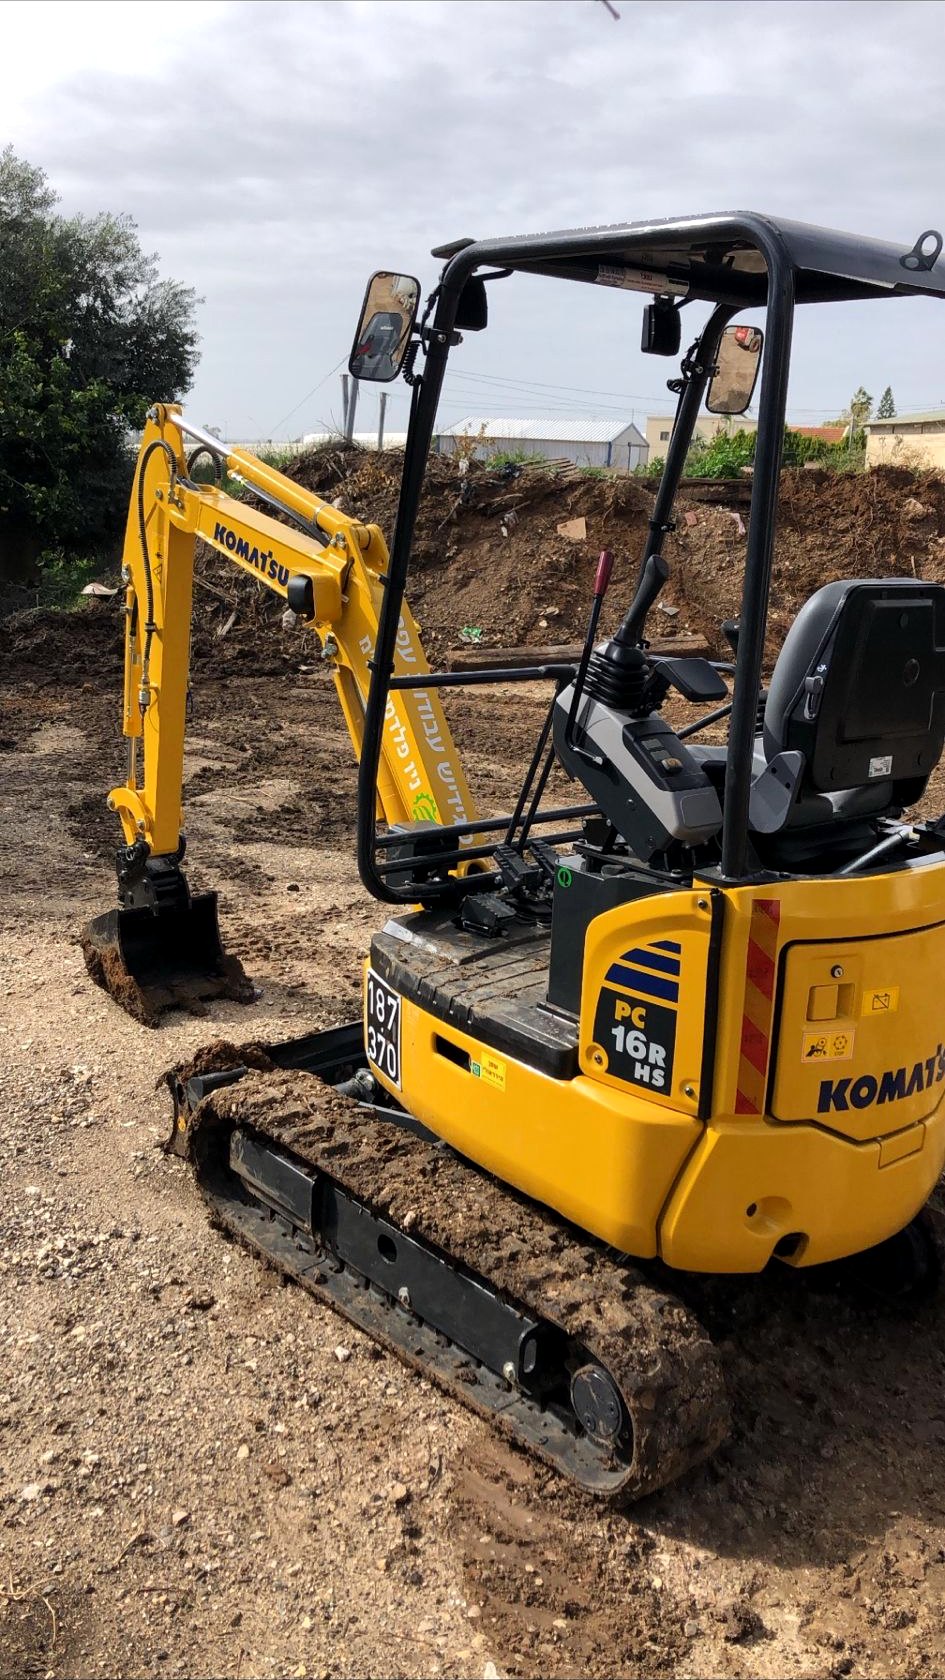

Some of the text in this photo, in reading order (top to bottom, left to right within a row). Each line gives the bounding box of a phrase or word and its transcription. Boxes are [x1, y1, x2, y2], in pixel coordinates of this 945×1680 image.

[214, 522, 289, 586] KOMATSU
[406, 672, 445, 752] עבודו
[384, 688, 422, 790] ניו פלדמ
[368, 981, 397, 1031] 187
[614, 999, 646, 1030] PC
[368, 1025, 396, 1078] 370
[611, 1024, 666, 1068] 16R
[634, 1061, 665, 1087] HS
